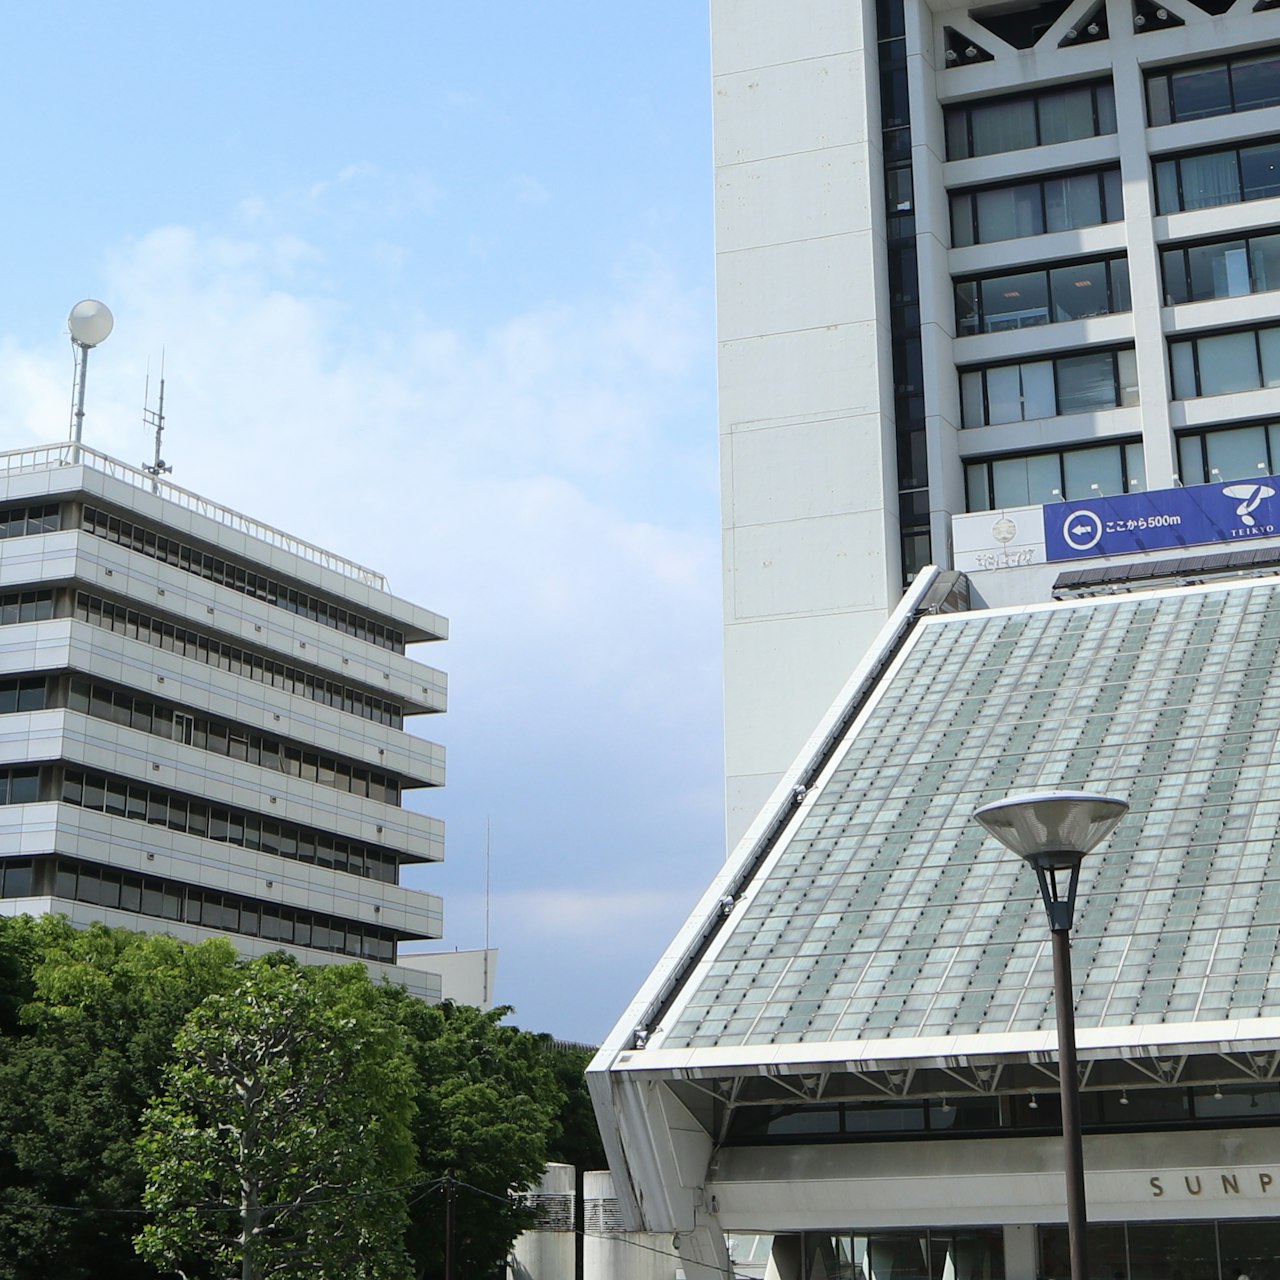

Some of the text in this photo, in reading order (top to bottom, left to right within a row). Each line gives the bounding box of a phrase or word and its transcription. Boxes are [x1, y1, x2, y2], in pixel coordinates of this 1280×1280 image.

[1105, 513, 1182, 534] ここから500m
[1231, 524, 1274, 538] TEIKYO
